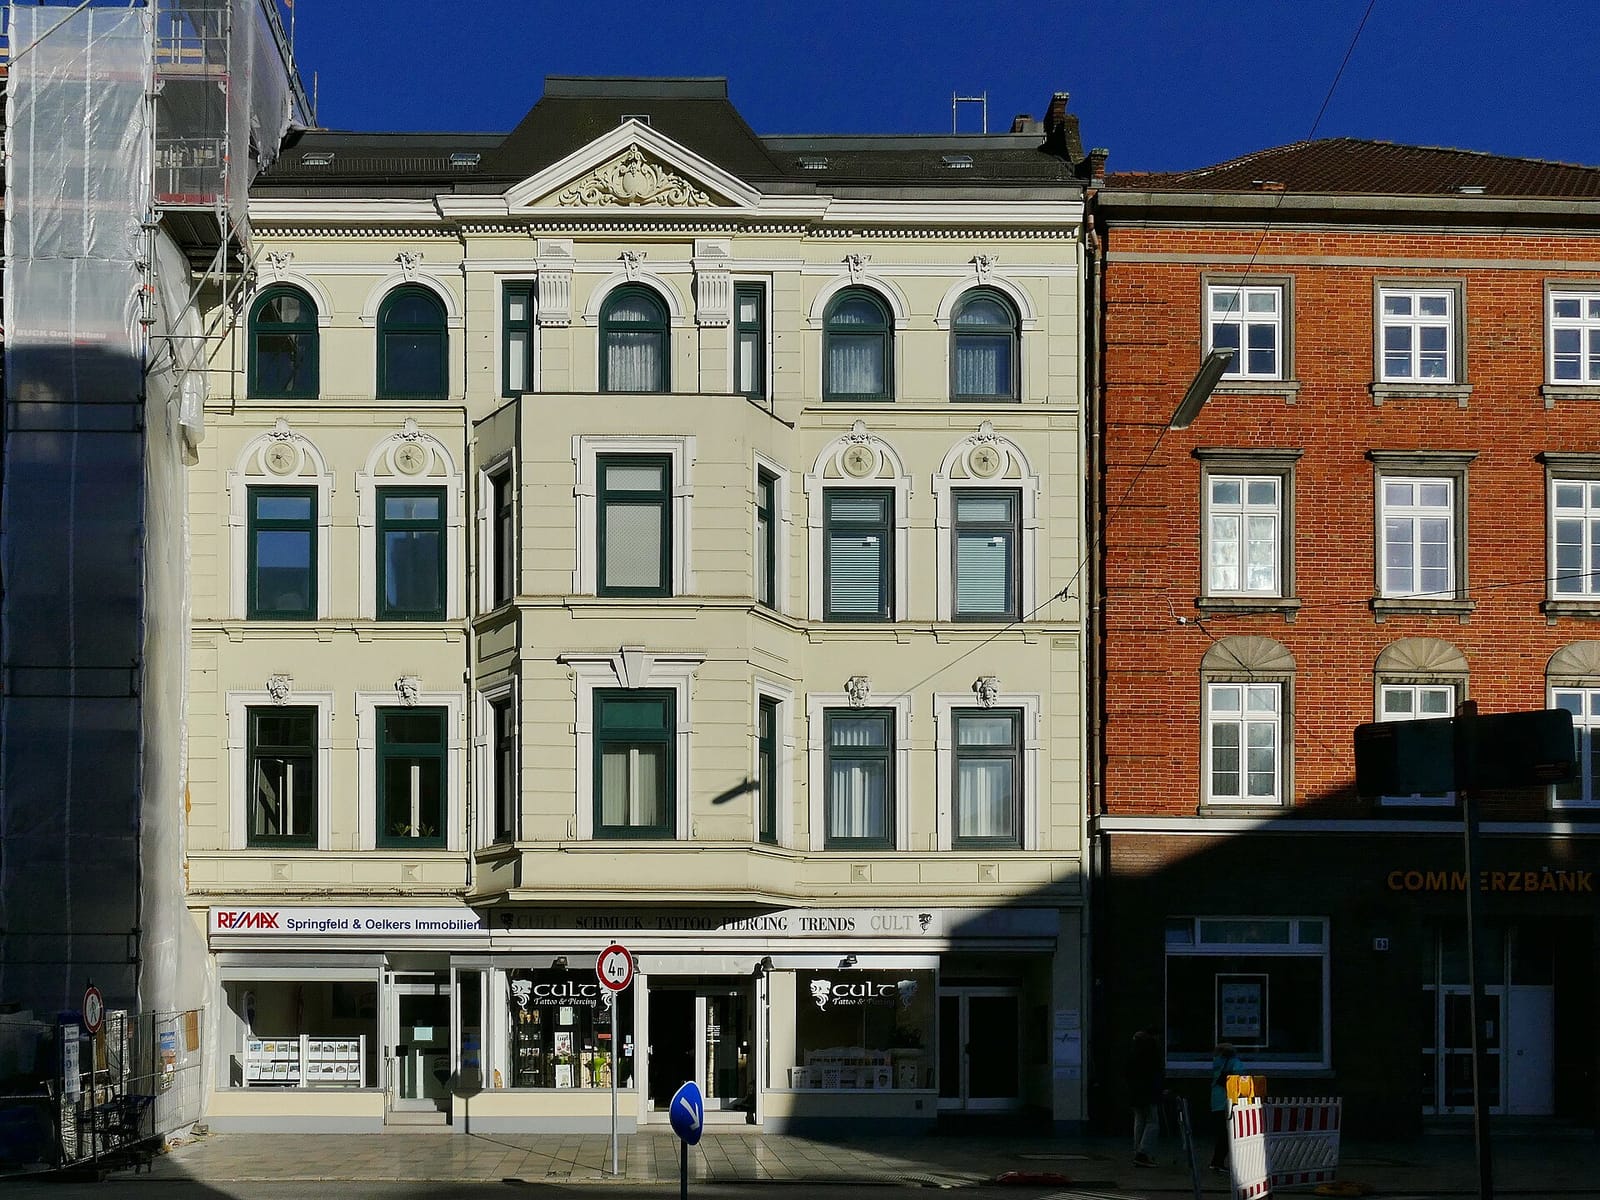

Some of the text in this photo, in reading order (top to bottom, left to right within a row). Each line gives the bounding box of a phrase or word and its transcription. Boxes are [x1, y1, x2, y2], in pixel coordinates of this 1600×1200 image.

[218, 911, 280, 929] RE/MAX
[287, 918, 481, 931] Springfeld & Oelkers Immobilien
[575, 916, 643, 929] SCHMUCK
[656, 916, 711, 930] TATTOO
[722, 916, 788, 930] PIERCING
[799, 917, 855, 931] TRENDS
[870, 915, 913, 930] CULT
[608, 959, 625, 976] 4 m
[533, 997, 597, 1009] Tattoo & Piercing
[832, 997, 856, 1006] Tattoo
